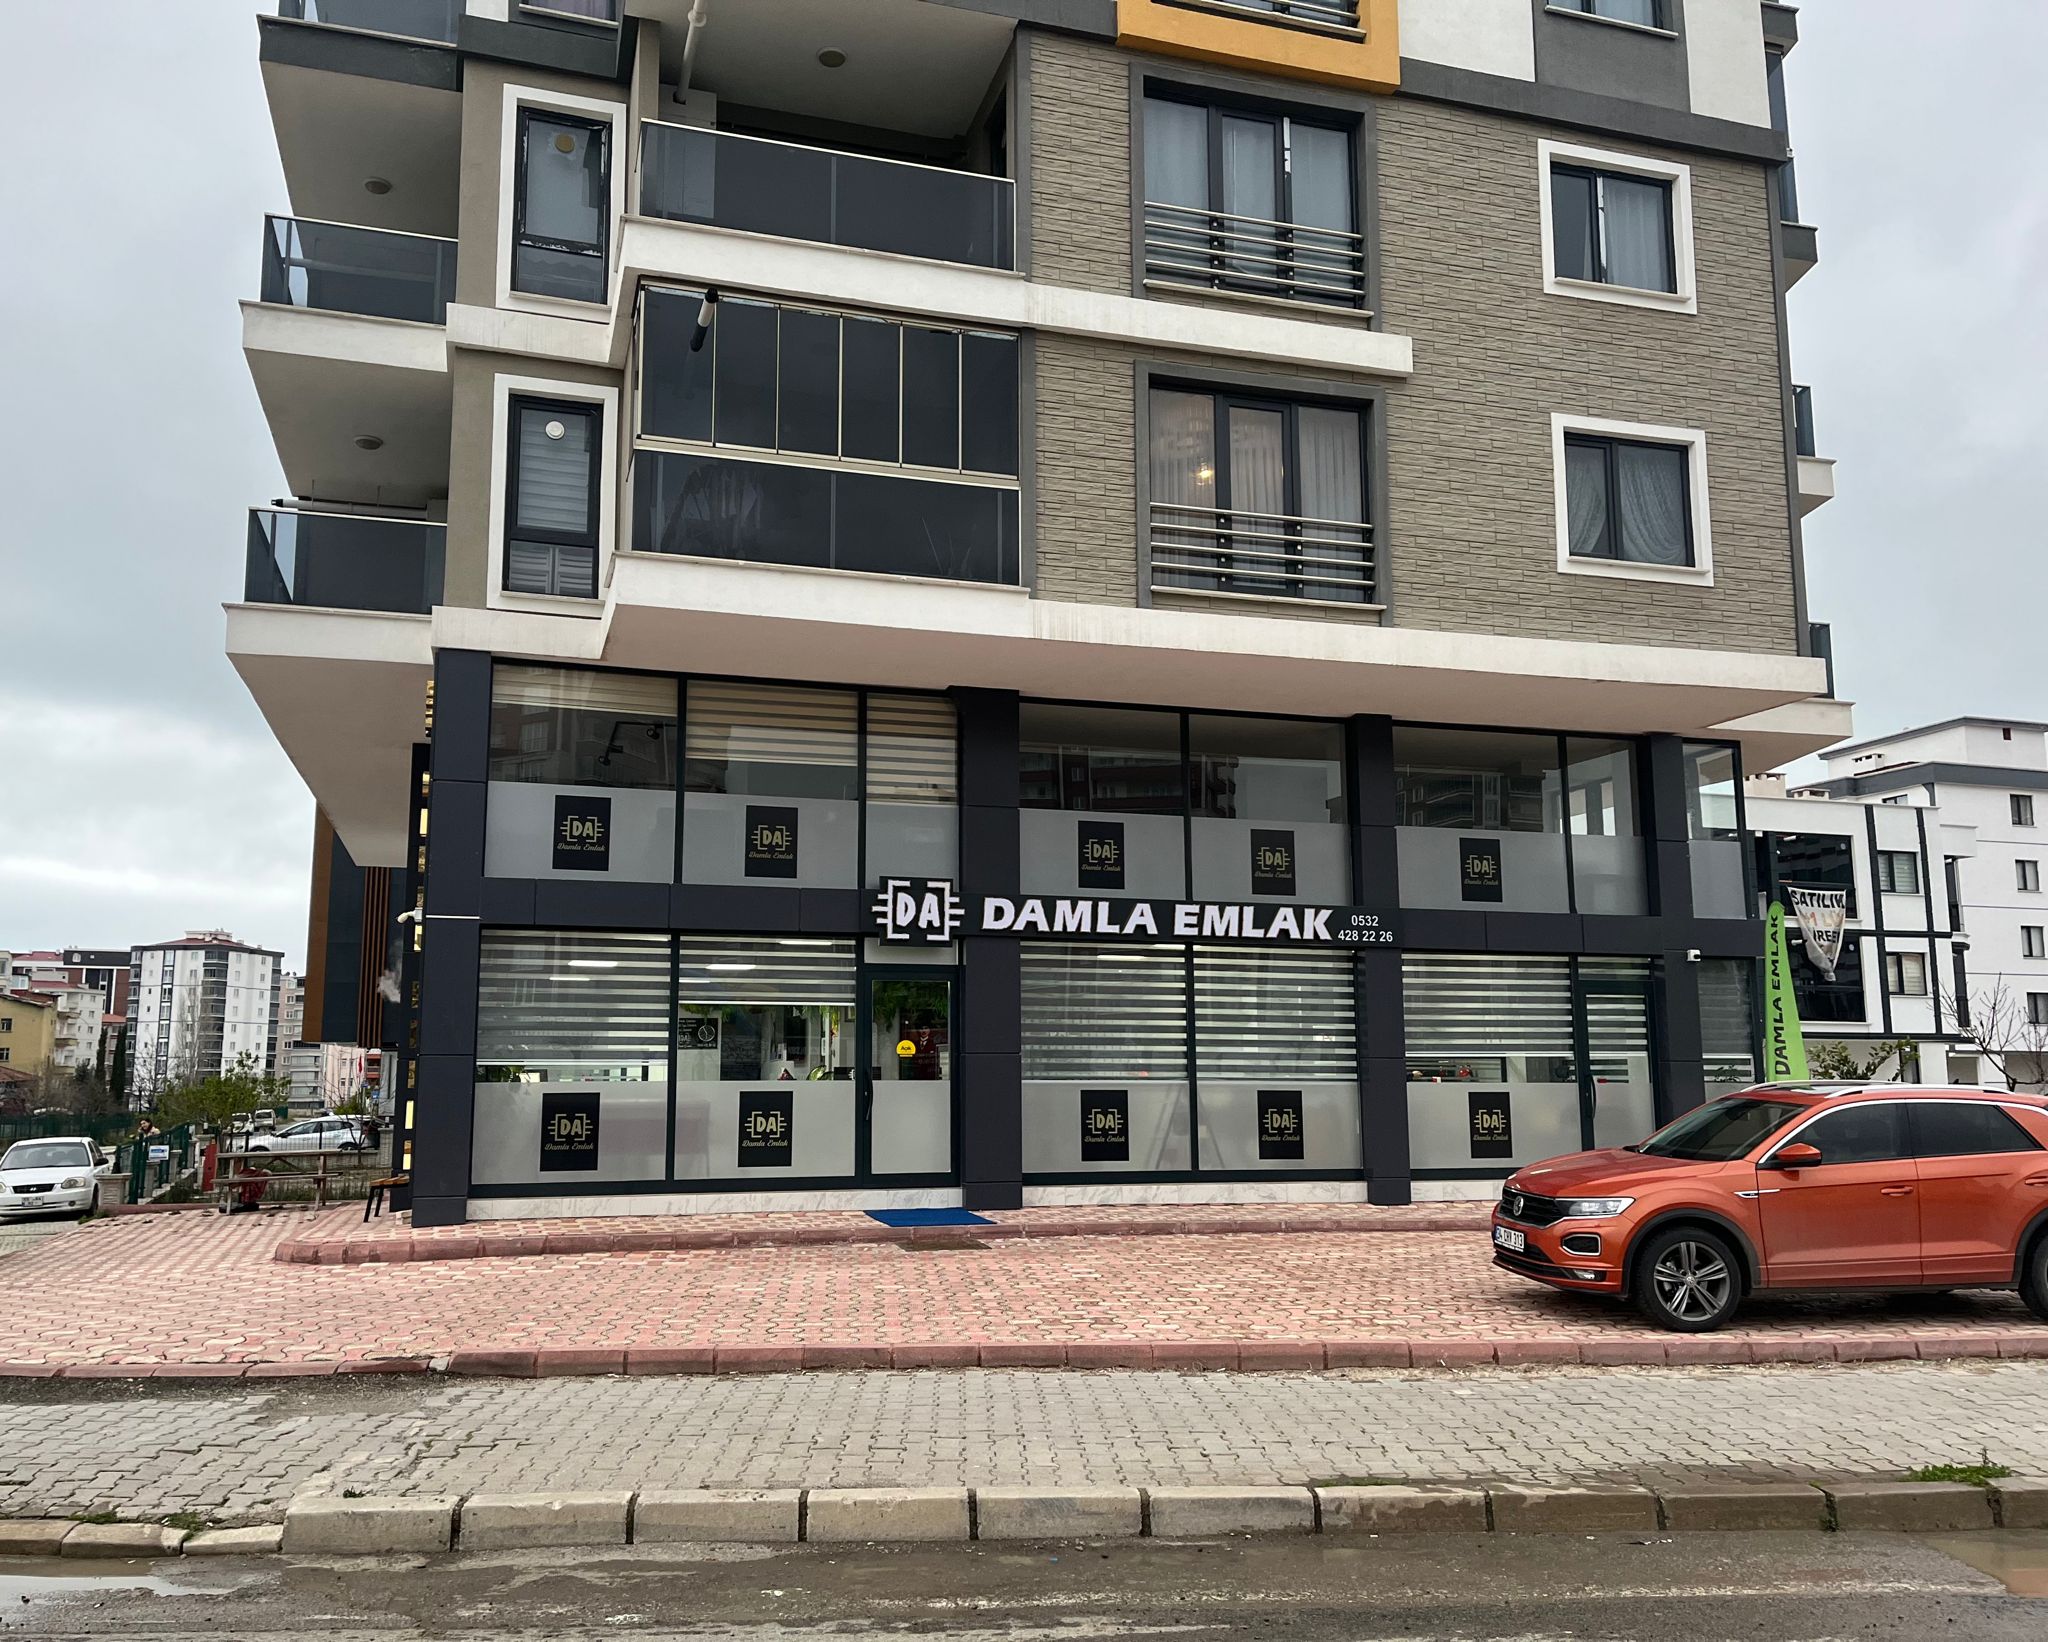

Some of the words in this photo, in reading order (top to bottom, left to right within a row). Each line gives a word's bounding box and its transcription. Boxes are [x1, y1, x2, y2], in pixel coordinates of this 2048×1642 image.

[572, 821, 594, 836] DA
[762, 830, 782, 846] DA
[1093, 844, 1110, 858] DA
[1266, 852, 1282, 866] DA
[1474, 860, 1490, 873] DA
[896, 892, 940, 928] DA
[981, 897, 1158, 935] DAMLA
[1174, 903, 1335, 940] EMLAK
[1351, 915, 1379, 927] 0532
[1338, 929, 1358, 941] 428
[1362, 930, 1376, 942] 22
[1380, 930, 1393, 942] 26
[1770, 914, 1781, 990] EMLAK
[1773, 996, 1791, 1076] DAMLA
[560, 1119, 582, 1135] DA
[756, 1116, 776, 1132] DA
[1096, 1114, 1114, 1129] DA
[1272, 1114, 1290, 1128] DA
[1482, 1114, 1499, 1128] DA
